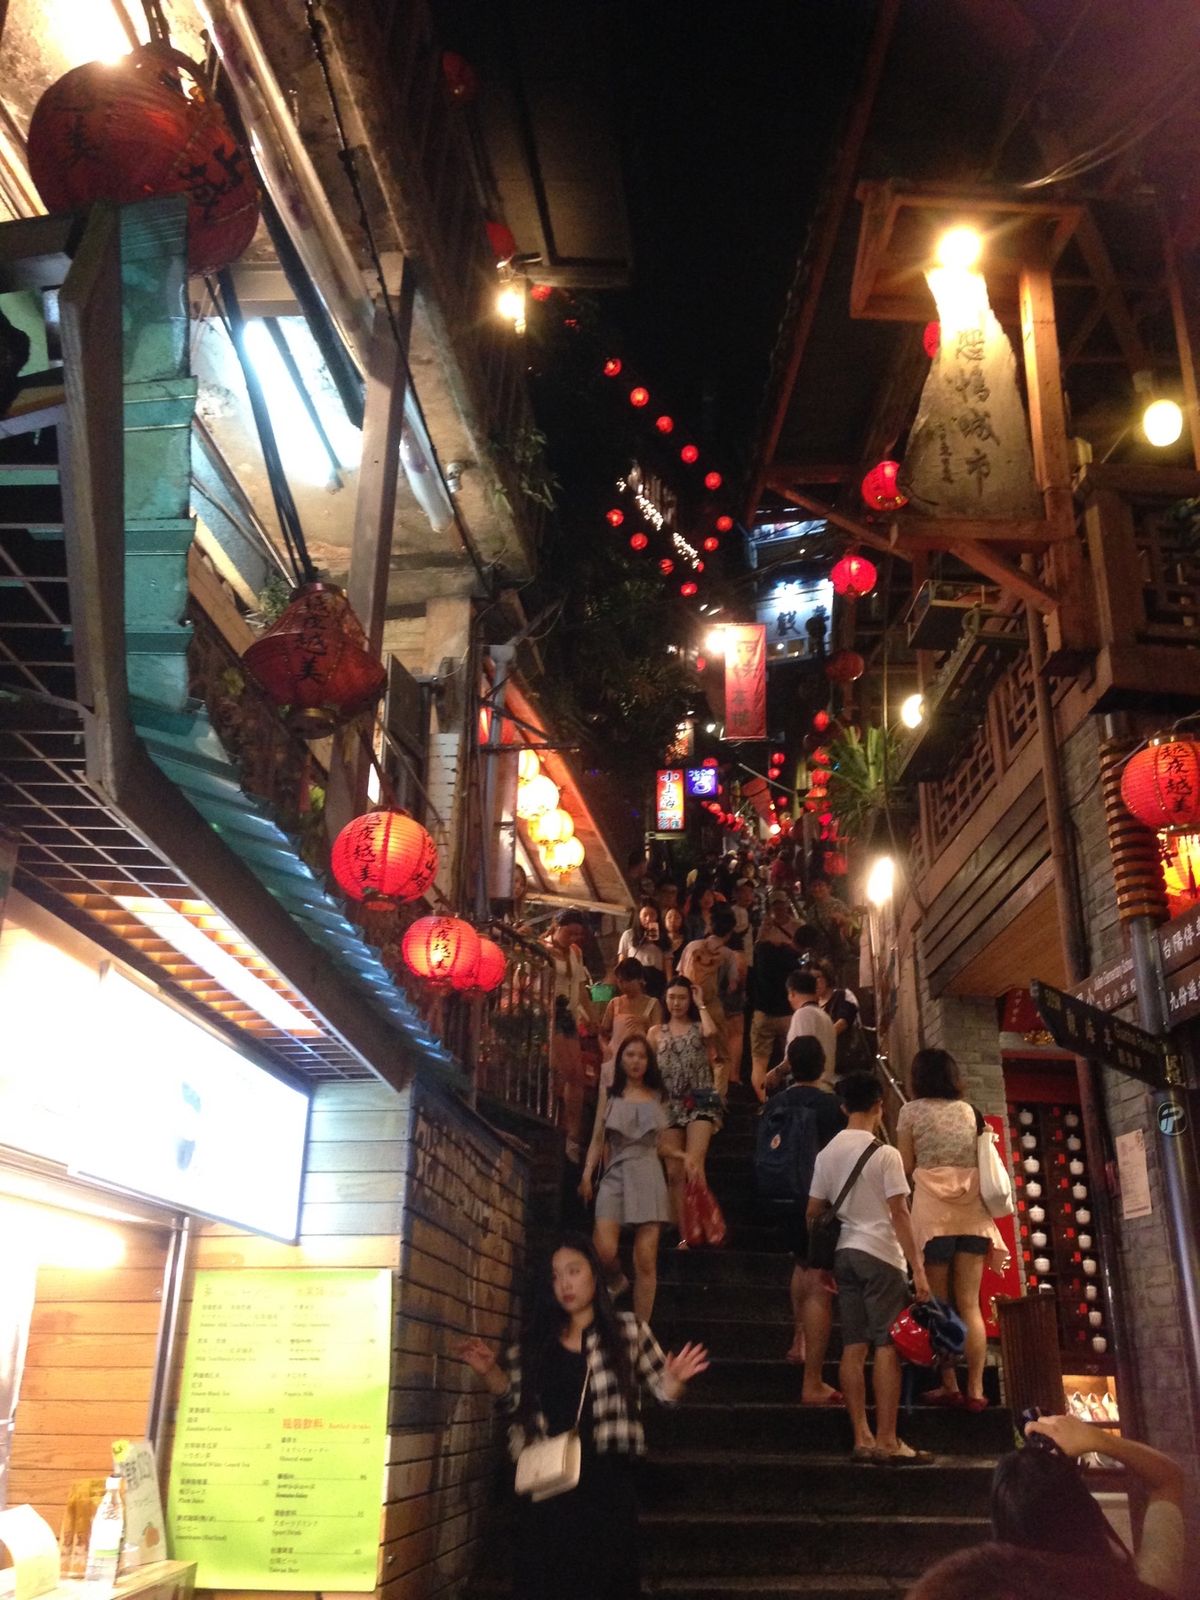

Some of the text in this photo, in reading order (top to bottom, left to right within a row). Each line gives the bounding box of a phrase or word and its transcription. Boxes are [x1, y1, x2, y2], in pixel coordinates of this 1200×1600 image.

[1160, 743, 1193, 815] 越夜越美
[352, 813, 382, 883] 越夜越美
